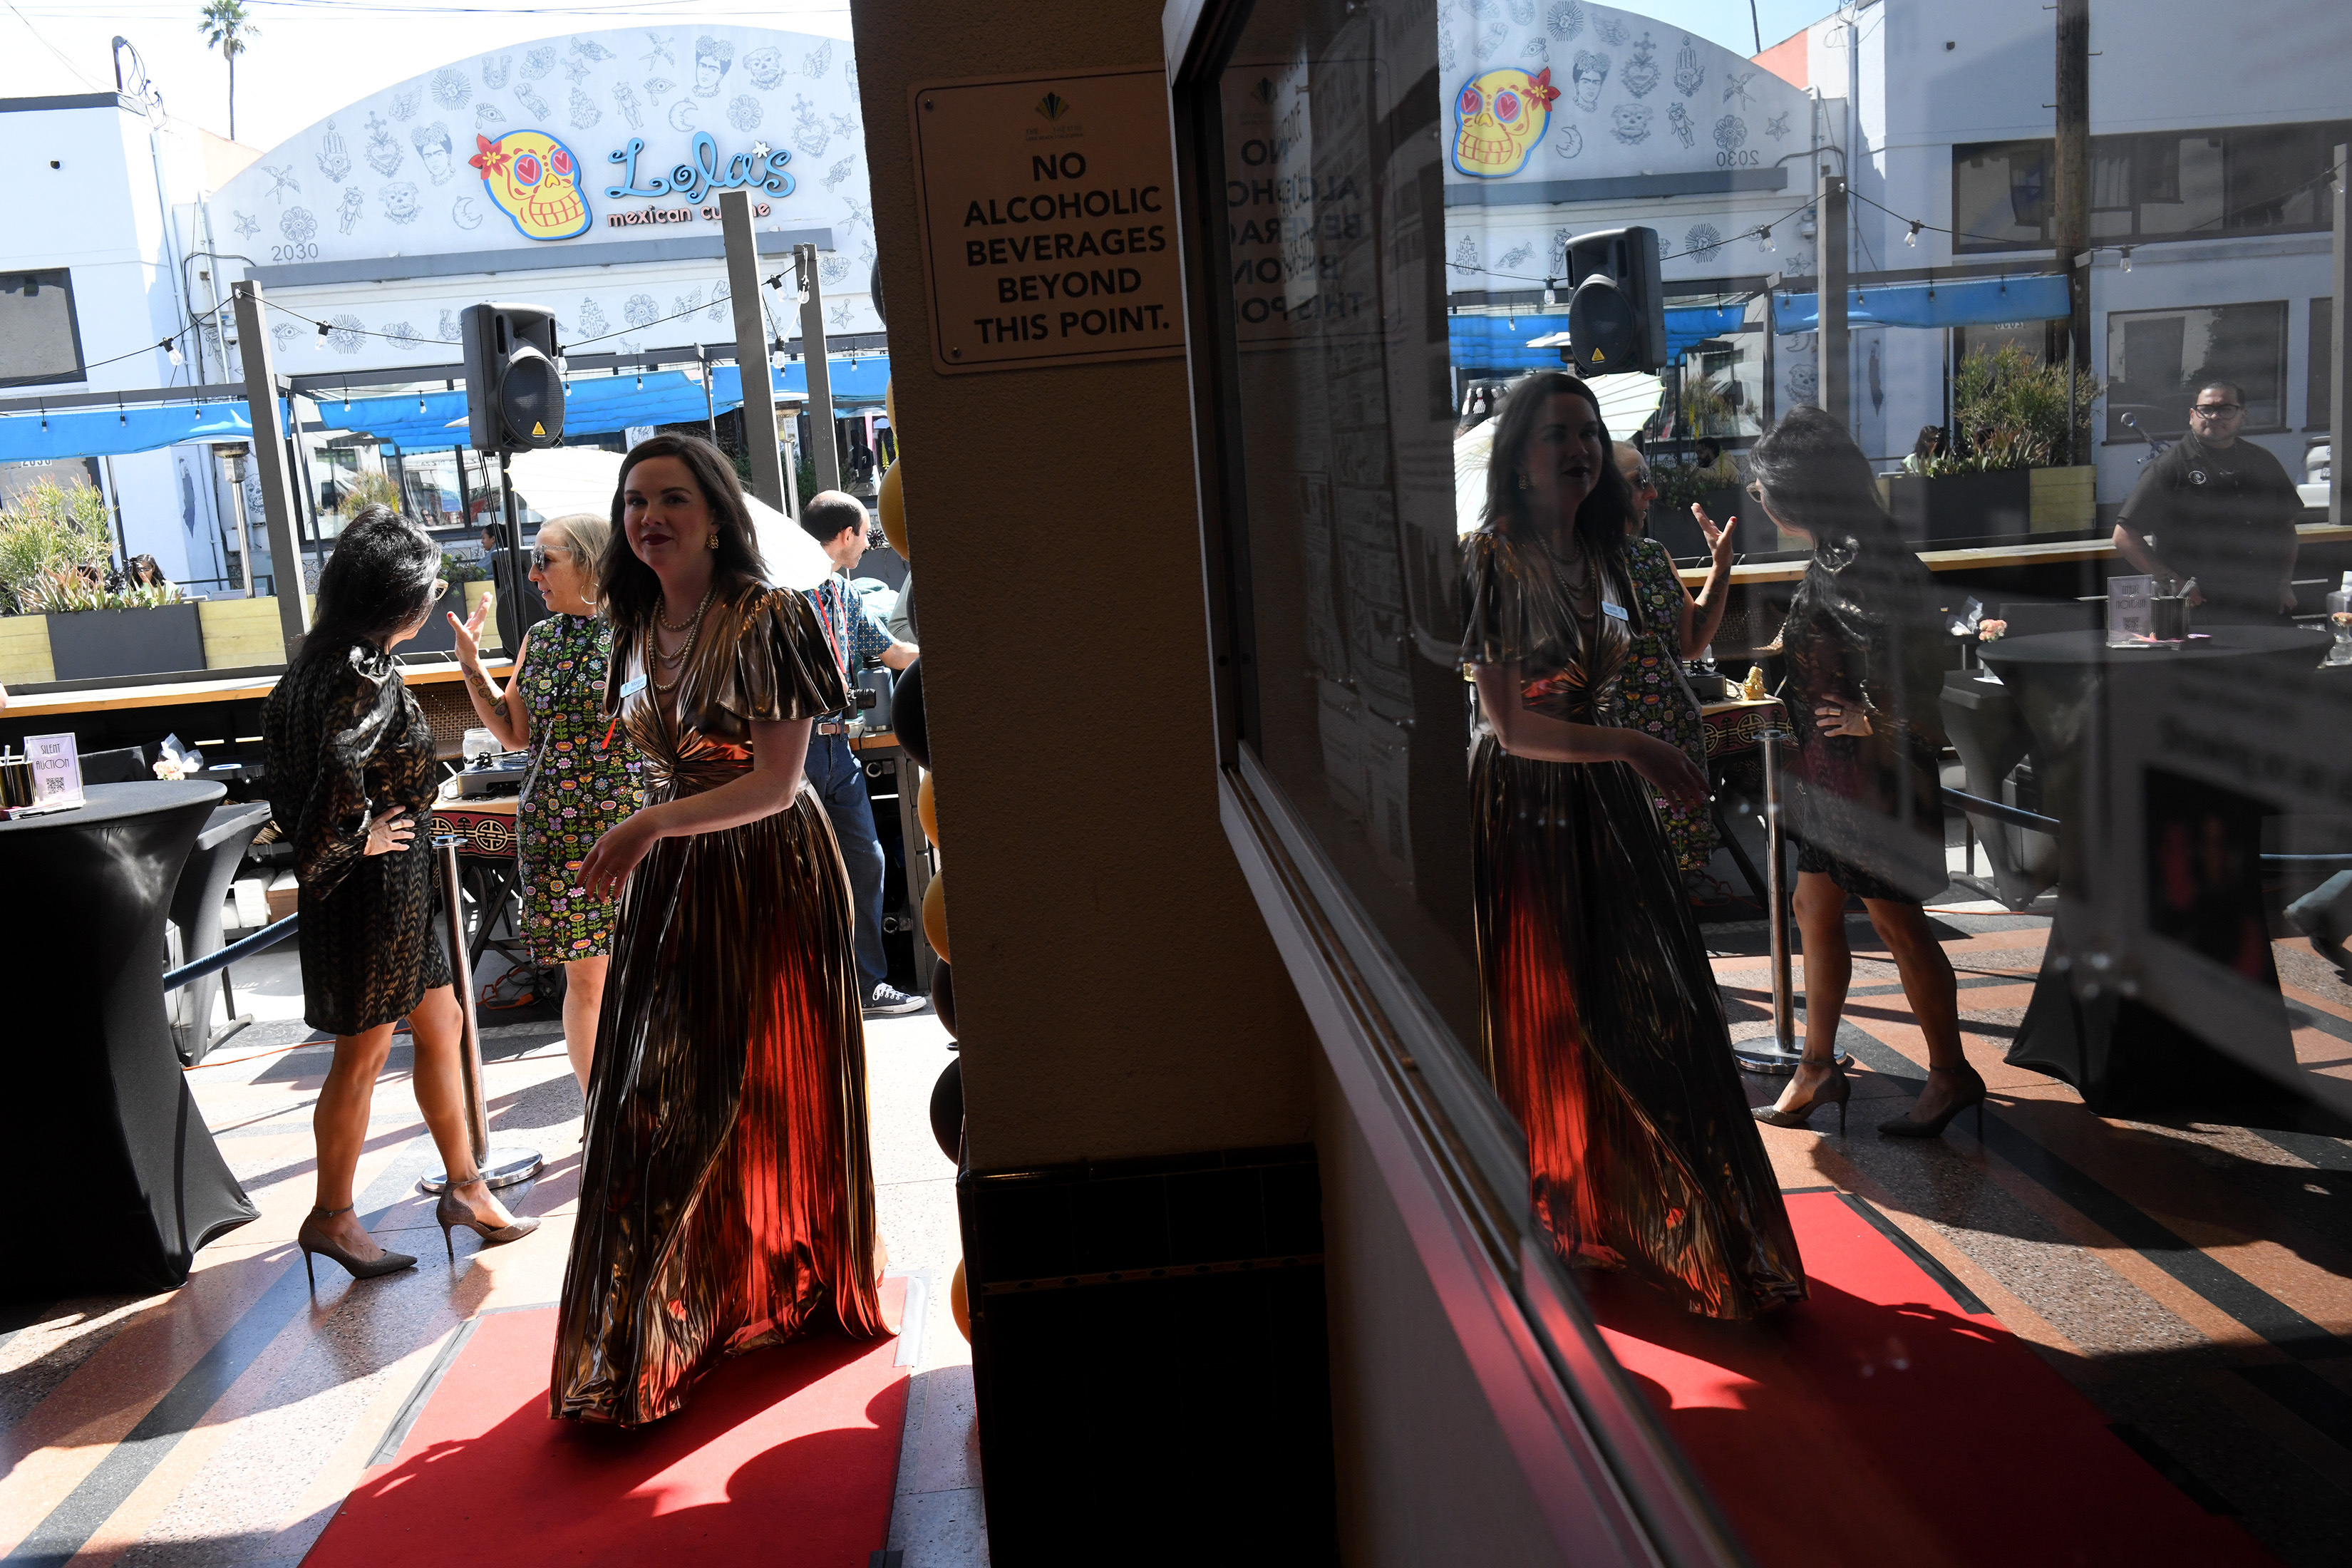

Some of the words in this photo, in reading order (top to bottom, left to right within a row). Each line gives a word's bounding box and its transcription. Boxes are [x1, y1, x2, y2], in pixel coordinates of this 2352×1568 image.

[1032, 152, 1087, 182] NO
[607, 205, 692, 227] mexican
[700, 202, 770, 220] cune
[964, 186, 1162, 227] ALCOHOLIC
[272, 243, 319, 261] 2030
[966, 225, 1166, 267] BEVERAGES
[998, 267, 1141, 304] BEYOND
[974, 314, 1048, 344] THIS
[1060, 304, 1170, 337] POINT.
[36, 758, 69, 770] AUCTION
[41, 743, 60, 755] SILENT
